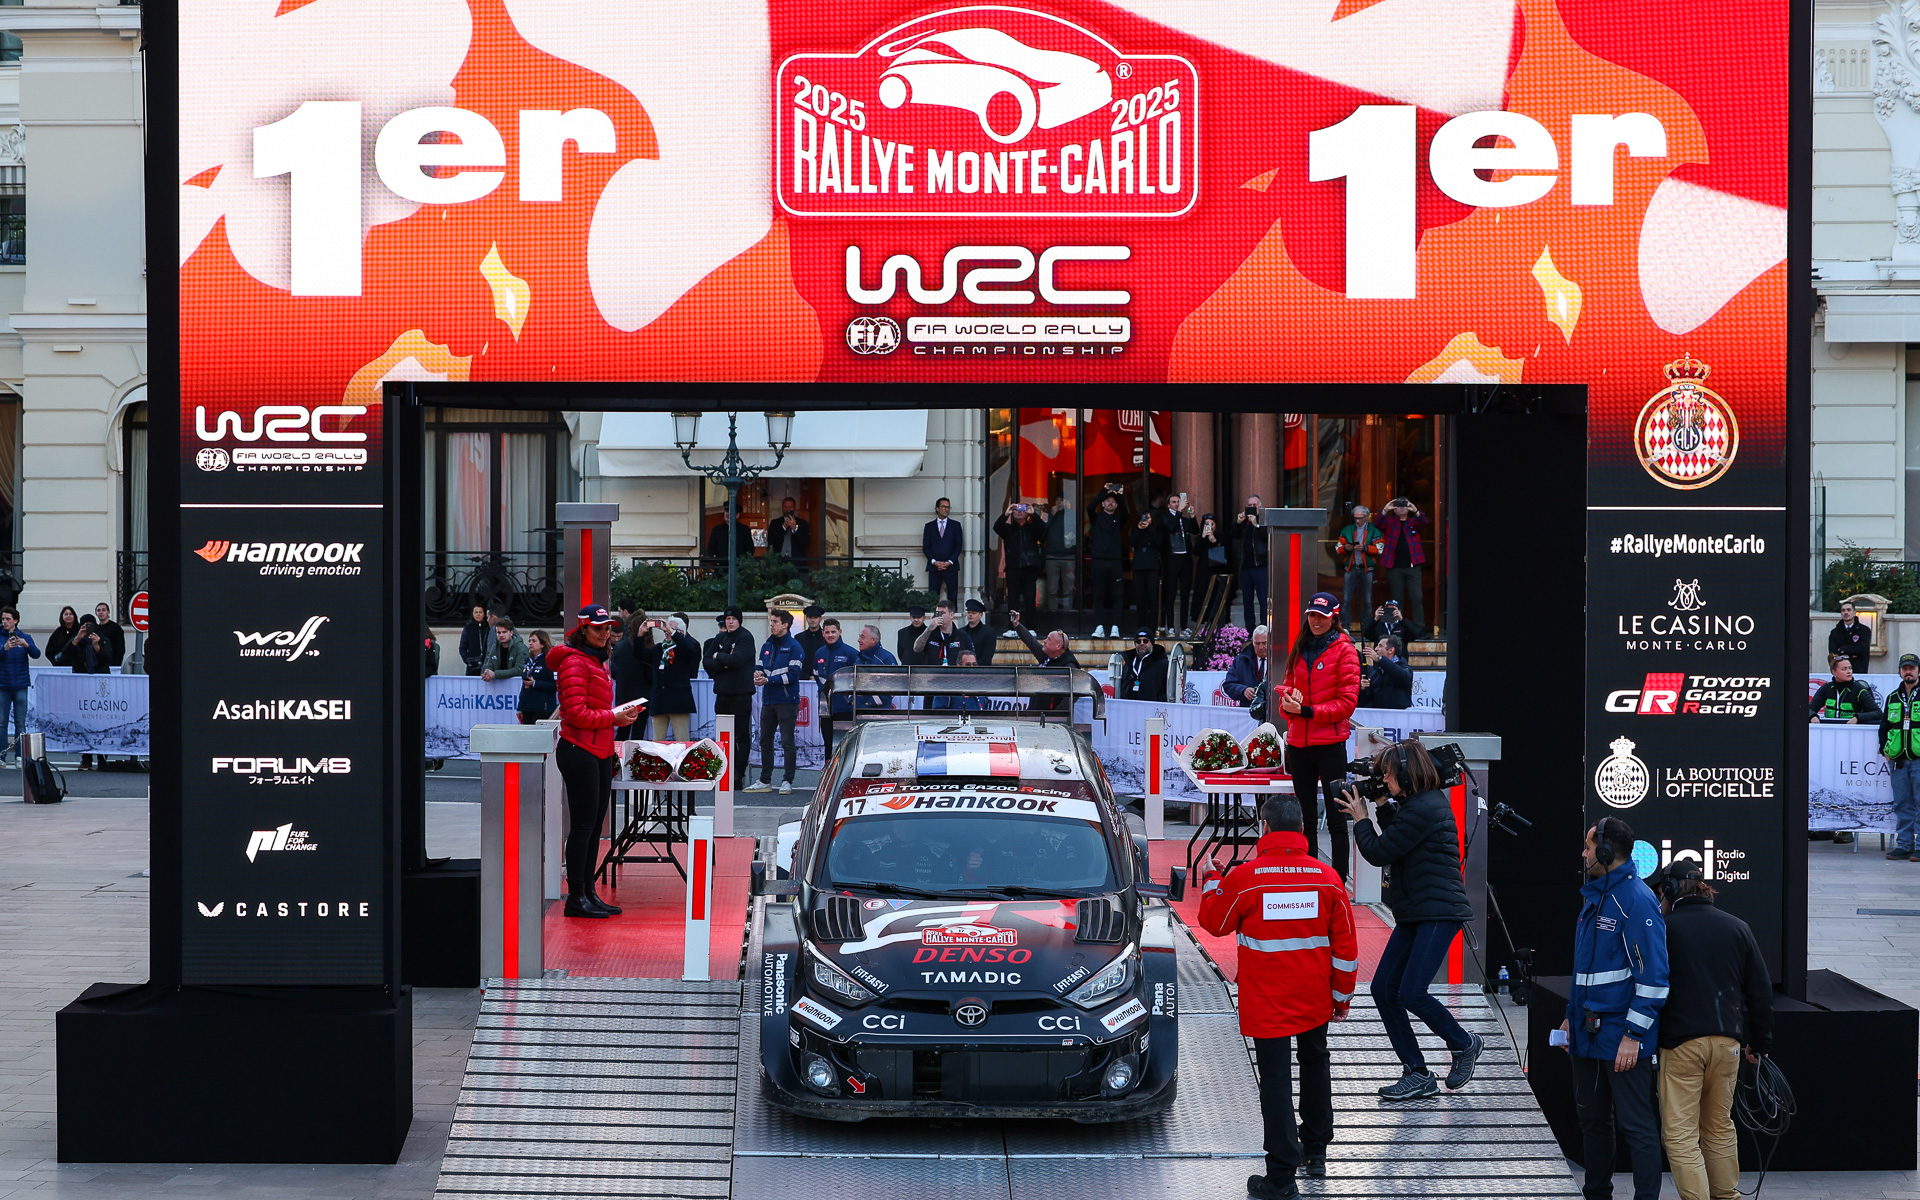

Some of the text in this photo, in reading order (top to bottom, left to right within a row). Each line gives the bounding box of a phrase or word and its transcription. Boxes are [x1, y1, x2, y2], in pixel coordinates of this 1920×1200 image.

[793, 75, 866, 131] 2025
[1110, 80, 1180, 132] 2025
[794, 111, 1181, 194] RALLYE MONTE-CARLO
[253, 101, 616, 296] 1er
[1309, 105, 1667, 299] 1er
[845, 245, 1131, 305] WRC
[913, 324, 1124, 337] FIA WORLD RALLY
[913, 345, 1124, 355] CHAMPIONSHIP
[195, 405, 367, 441] WRC
[236, 452, 363, 460] FIA WORLD RALLY
[1610, 534, 1765, 557] #RallyeMonteCarlo
[259, 564, 361, 578] driving emotion
[1618, 614, 1755, 636] LE CASINO
[239, 648, 292, 657] LUBRICANTS
[1688, 675, 1771, 688] TOYOTA
[1604, 689, 1679, 714] GR
[1685, 689, 1762, 701] GAZOO
[78, 699, 129, 712] LE CASINO
[212, 699, 352, 720] AsahiKASEI
[1682, 701, 1758, 718] Racing
[1129, 732, 1141, 745] LE
[212, 757, 352, 774] FORUM8
[1840, 761, 1858, 775] LE
[248, 775, 315, 785] フォーラムエイト
[1666, 768, 1774, 784] LA BOUTIQUE
[899, 784, 960, 792] TOYOTA
[963, 783, 1018, 792] GAZOO
[1020, 786, 1072, 798] Racing
[1666, 783, 1774, 798] OFFICIELLE
[843, 799, 867, 816] 17
[285, 843, 318, 851] CHANGE
[1716, 849, 1746, 860] Radio
[1255, 866, 1283, 874] AUTOMOBILE
[1717, 859, 1730, 870] TV
[1716, 870, 1750, 883] Digital
[235, 902, 370, 917] CASTORE
[1267, 902, 1315, 910] COMMISSAIRE
[926, 934, 1014, 944] RALLYE MONTE-CARLO
[912, 947, 1033, 964] DENSO
[763, 952, 774, 1017] AUTOMOTIVE
[775, 953, 789, 1015] Panasonic
[920, 971, 1022, 985] TAMADIC
